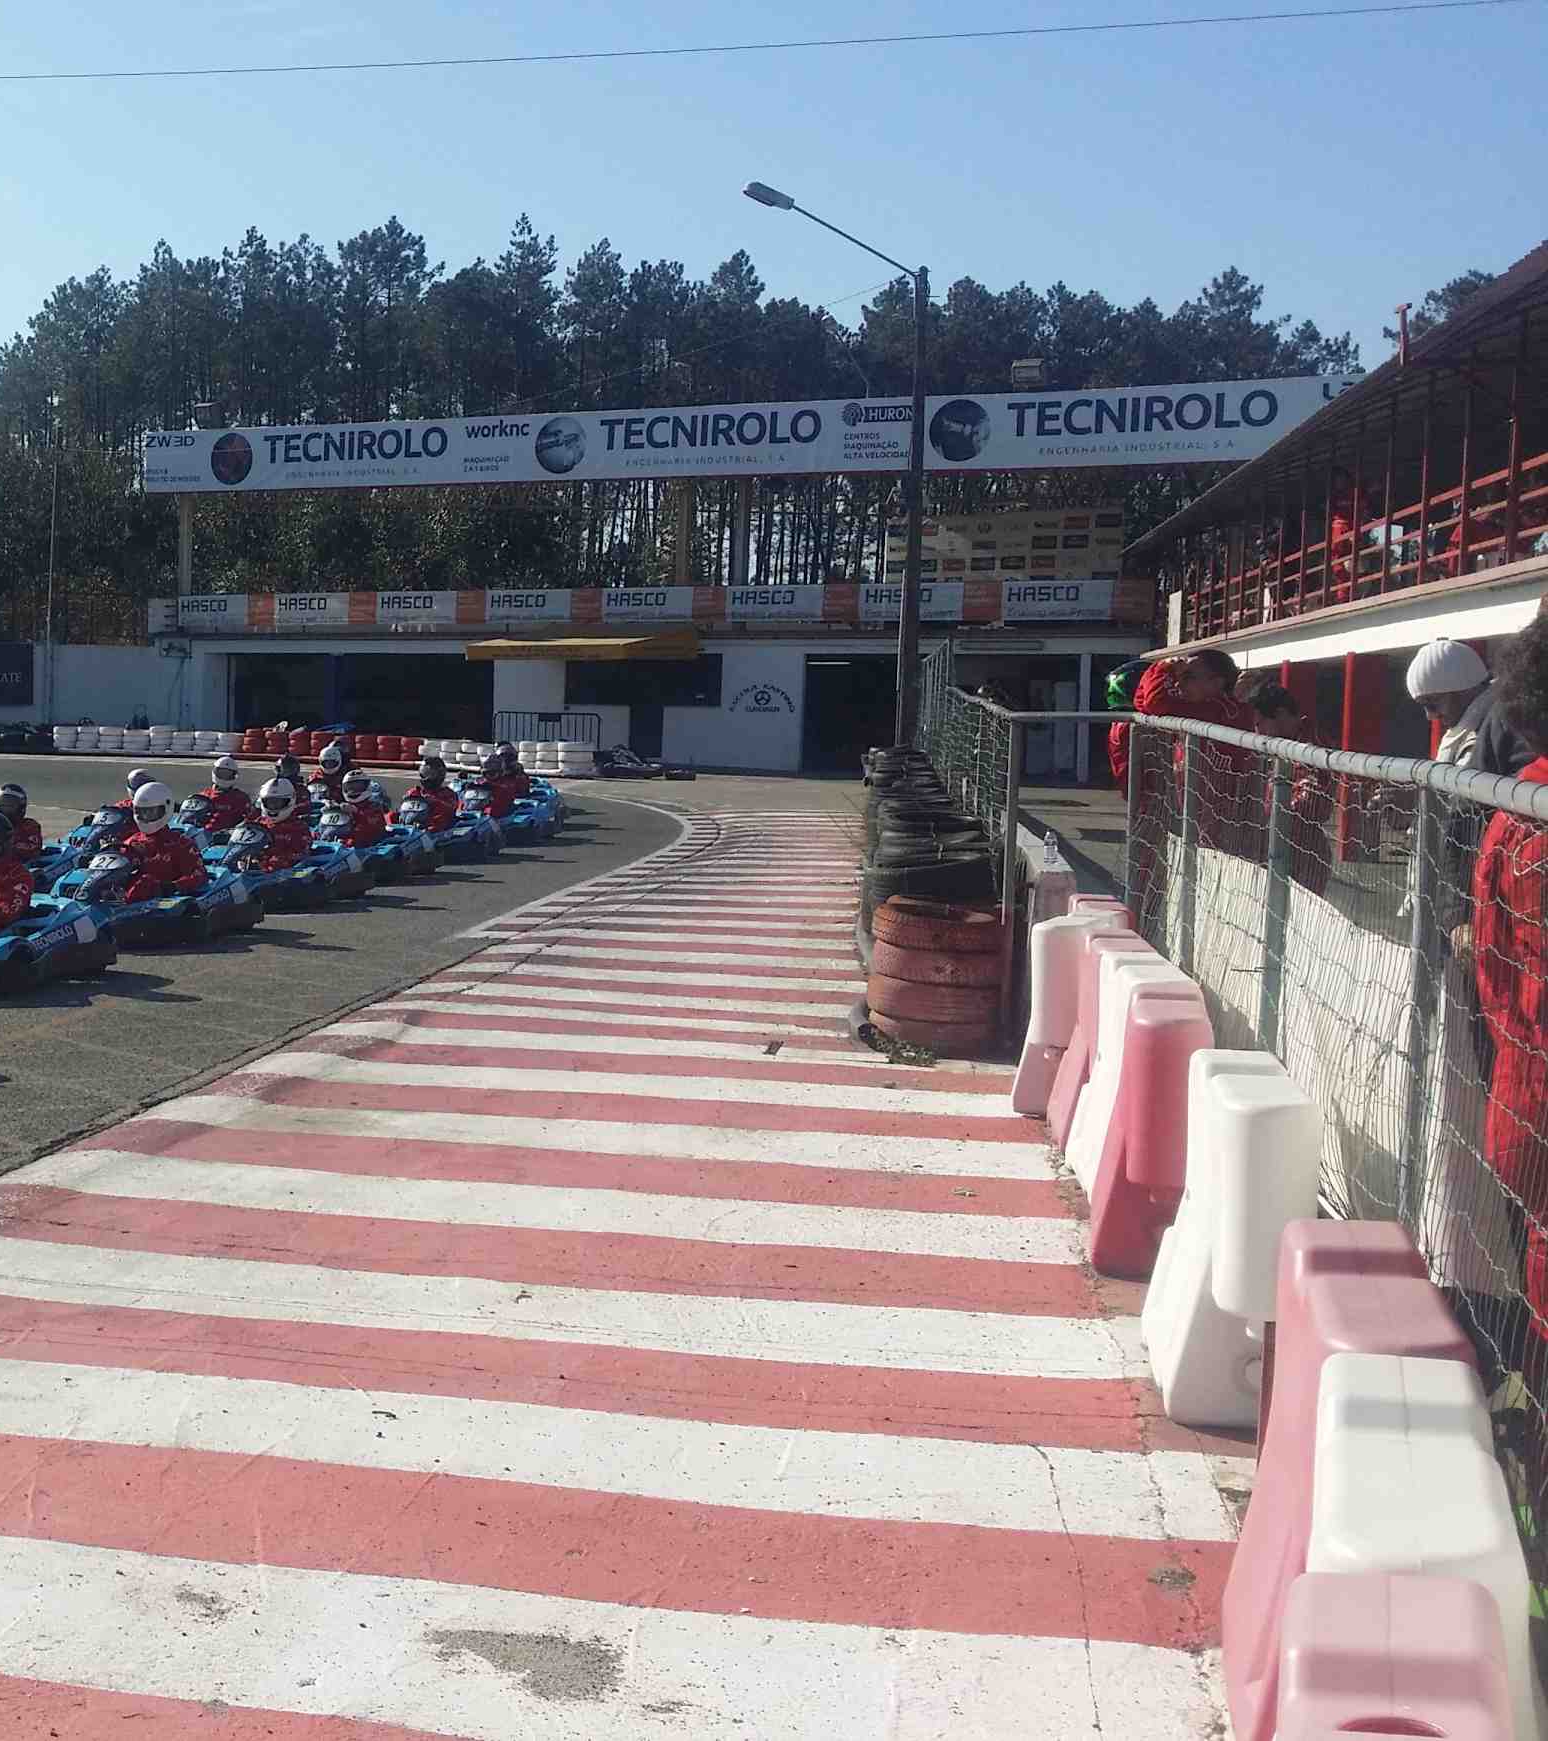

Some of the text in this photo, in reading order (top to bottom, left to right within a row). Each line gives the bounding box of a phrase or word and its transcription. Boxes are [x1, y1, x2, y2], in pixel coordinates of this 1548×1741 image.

[869, 407, 914, 421] HURON
[1007, 389, 1278, 436] TECNIROLO
[465, 419, 529, 438] worknc
[600, 409, 822, 450] TECNIROLO
[844, 432, 880, 441] CENTROS
[263, 427, 448, 464] TECNIROLO
[490, 594, 546, 608] HASCO
[606, 592, 668, 607] HASCO
[732, 590, 794, 605] HASCO
[865, 588, 932, 603] HASO
[1007, 586, 1080, 602] HASCO
[181, 599, 227, 612] HASCO
[278, 598, 327, 610] HASCO
[380, 596, 433, 609] HASCO
[95, 856, 117, 868] 27
